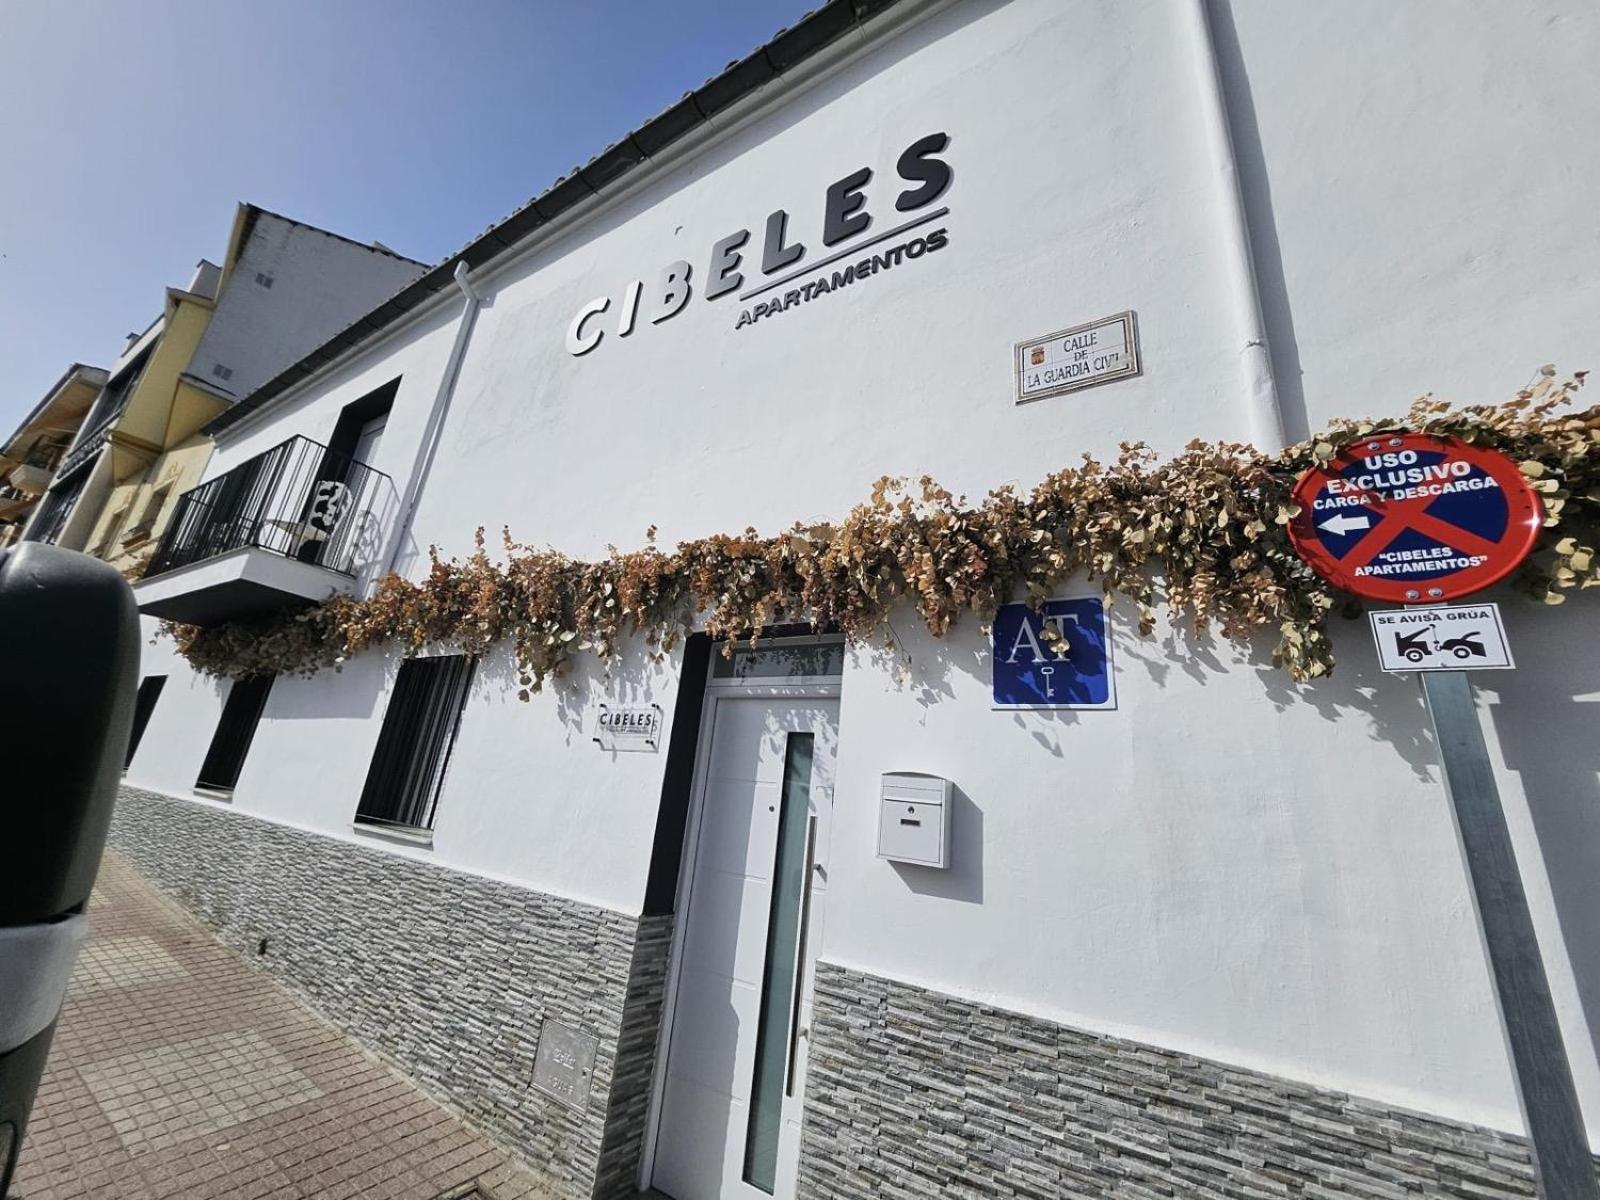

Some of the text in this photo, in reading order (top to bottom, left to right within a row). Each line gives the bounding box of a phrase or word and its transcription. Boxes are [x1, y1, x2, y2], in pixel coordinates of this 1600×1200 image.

[565, 132, 953, 357] CIBELES
[735, 228, 949, 330] APARTAMENTOS
[1063, 332, 1098, 353] CALLE
[1074, 350, 1088, 362] DE
[1028, 373, 1041, 388] LA
[1044, 361, 1090, 384] GUARDIA
[1364, 450, 1418, 471] USO
[1326, 460, 1471, 495] EXCLUSIVO
[1313, 494, 1372, 511] CARGA
[1393, 475, 1498, 501] DESCARGA
[1378, 610, 1490, 625] SE AVISA GRÚA
[1005, 613, 1079, 664] AT
[600, 713, 652, 726] CIBELES
